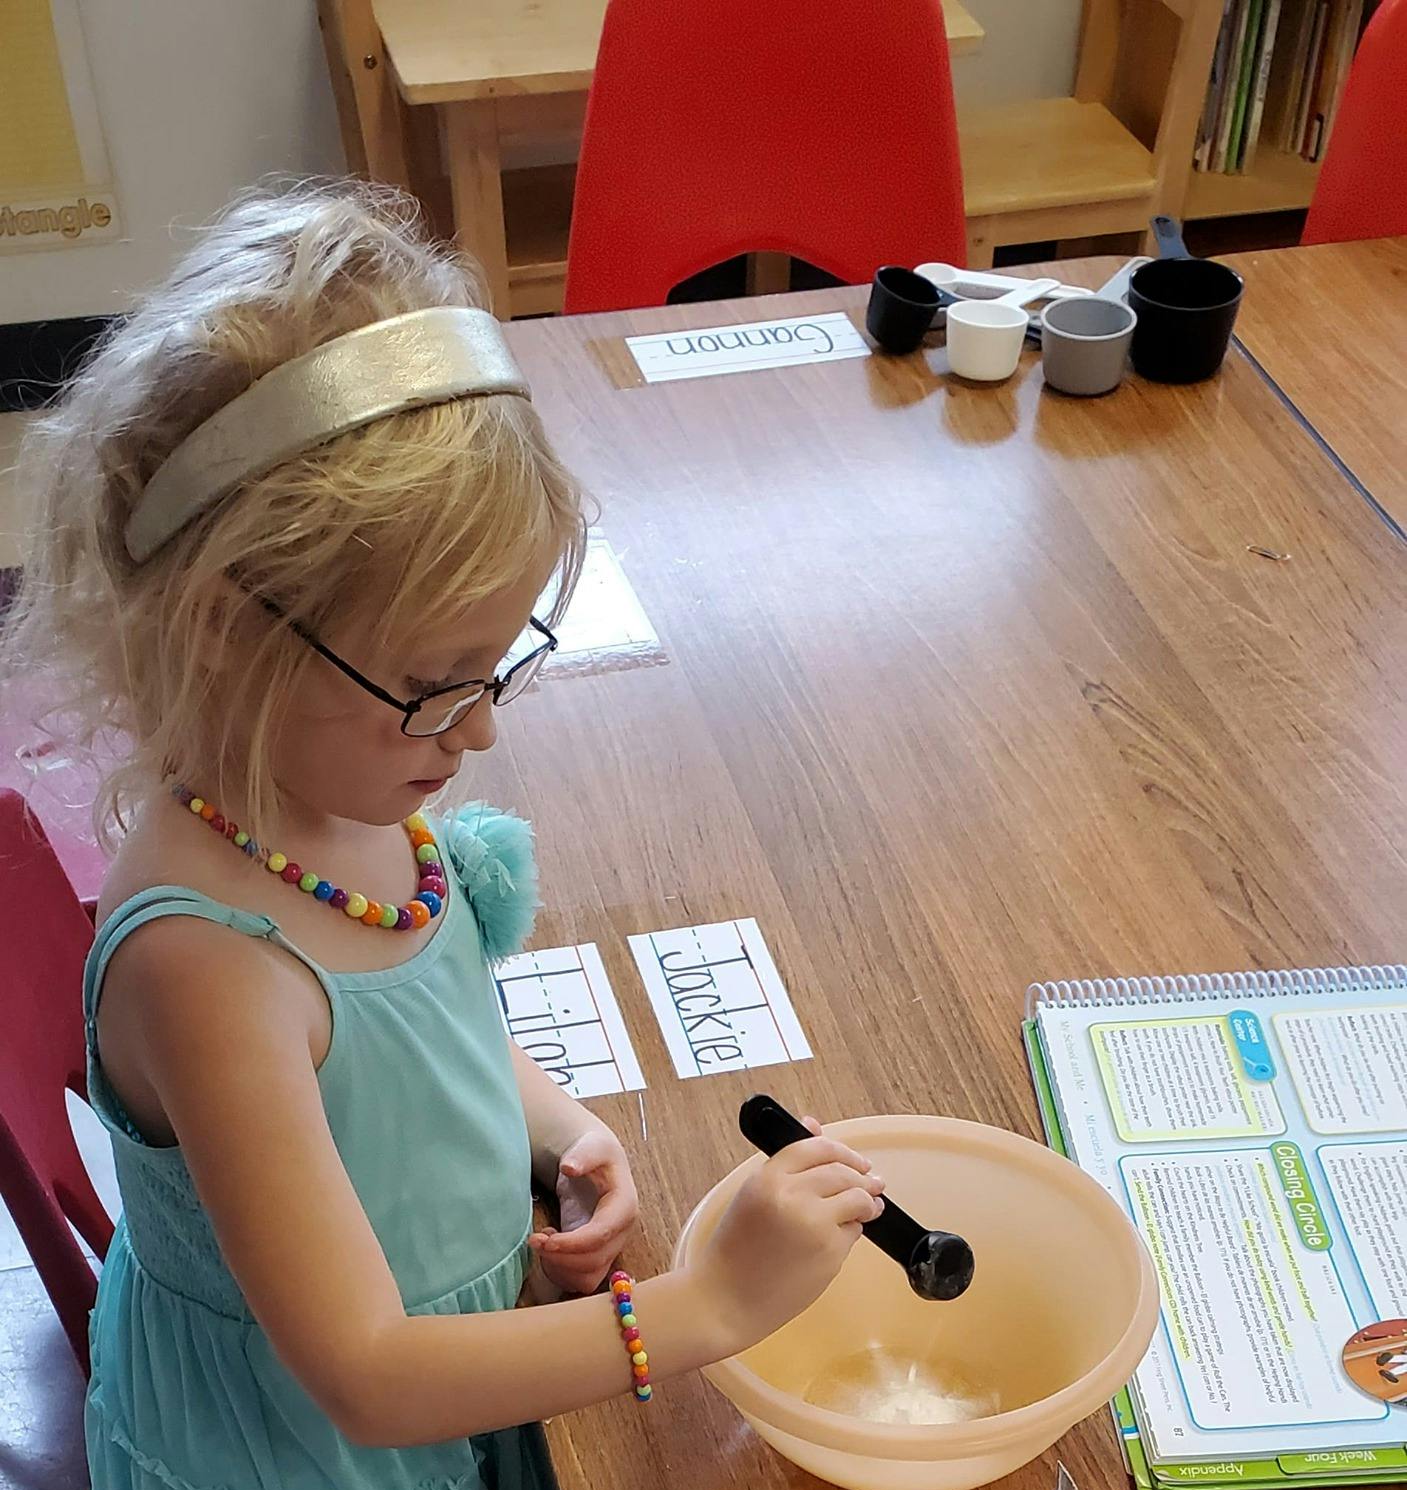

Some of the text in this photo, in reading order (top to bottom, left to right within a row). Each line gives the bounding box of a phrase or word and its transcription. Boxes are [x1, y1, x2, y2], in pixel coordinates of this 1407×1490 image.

[0, 198, 112, 239] tangle
[666, 323, 835, 355] Gannon
[660, 945, 768, 1064] Jackie
[1244, 1017, 1260, 1044] Science
[1063, 1033, 1076, 1060] School
[1070, 1061, 1082, 1078] and
[1074, 1078, 1085, 1092] Me
[1085, 1114, 1096, 1126] Mi
[1088, 1126, 1103, 1157] escuela
[1095, 1164, 1107, 1176] yo
[1276, 1145, 1325, 1246] Closing Circle
[1178, 1462, 1244, 1478] Appendix
[1305, 1450, 1377, 1464] Week Four
